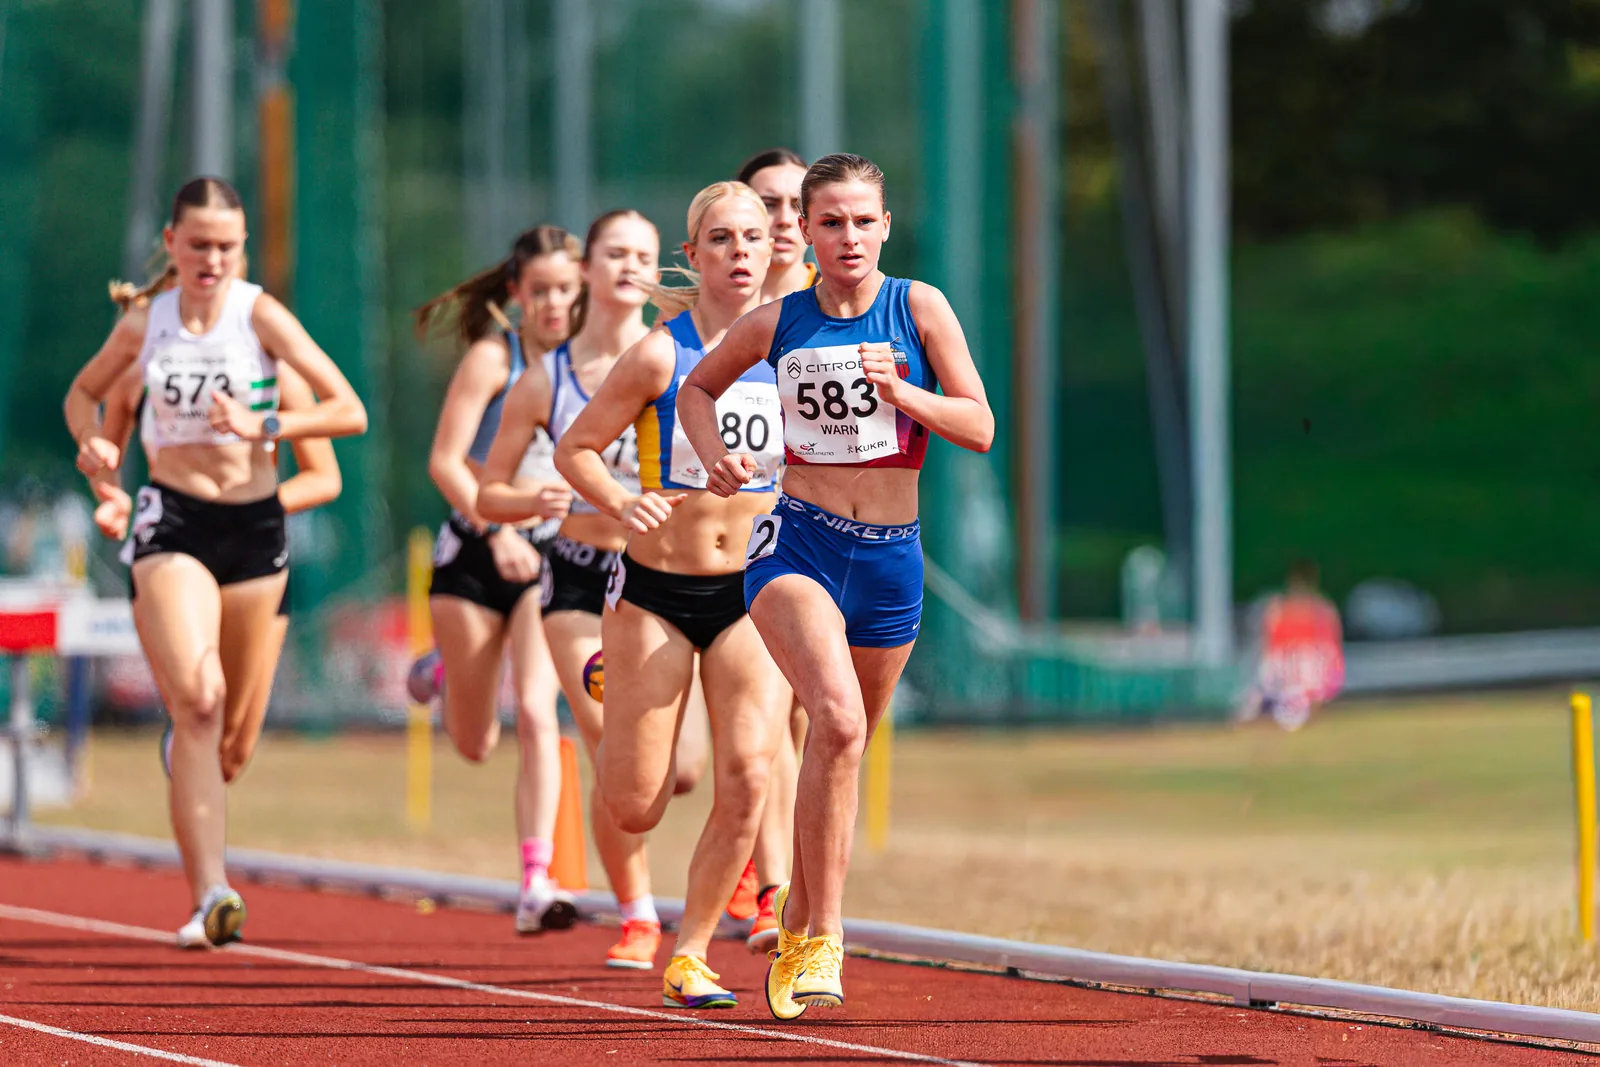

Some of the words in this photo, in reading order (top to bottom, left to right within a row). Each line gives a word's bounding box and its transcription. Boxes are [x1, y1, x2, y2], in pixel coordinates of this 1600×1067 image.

[797, 377, 878, 421] 583
[720, 412, 769, 452] 80
[820, 424, 859, 435] WARN
[855, 440, 888, 453] KUKRI
[747, 519, 775, 560] 2
[813, 512, 883, 540] NIKE
